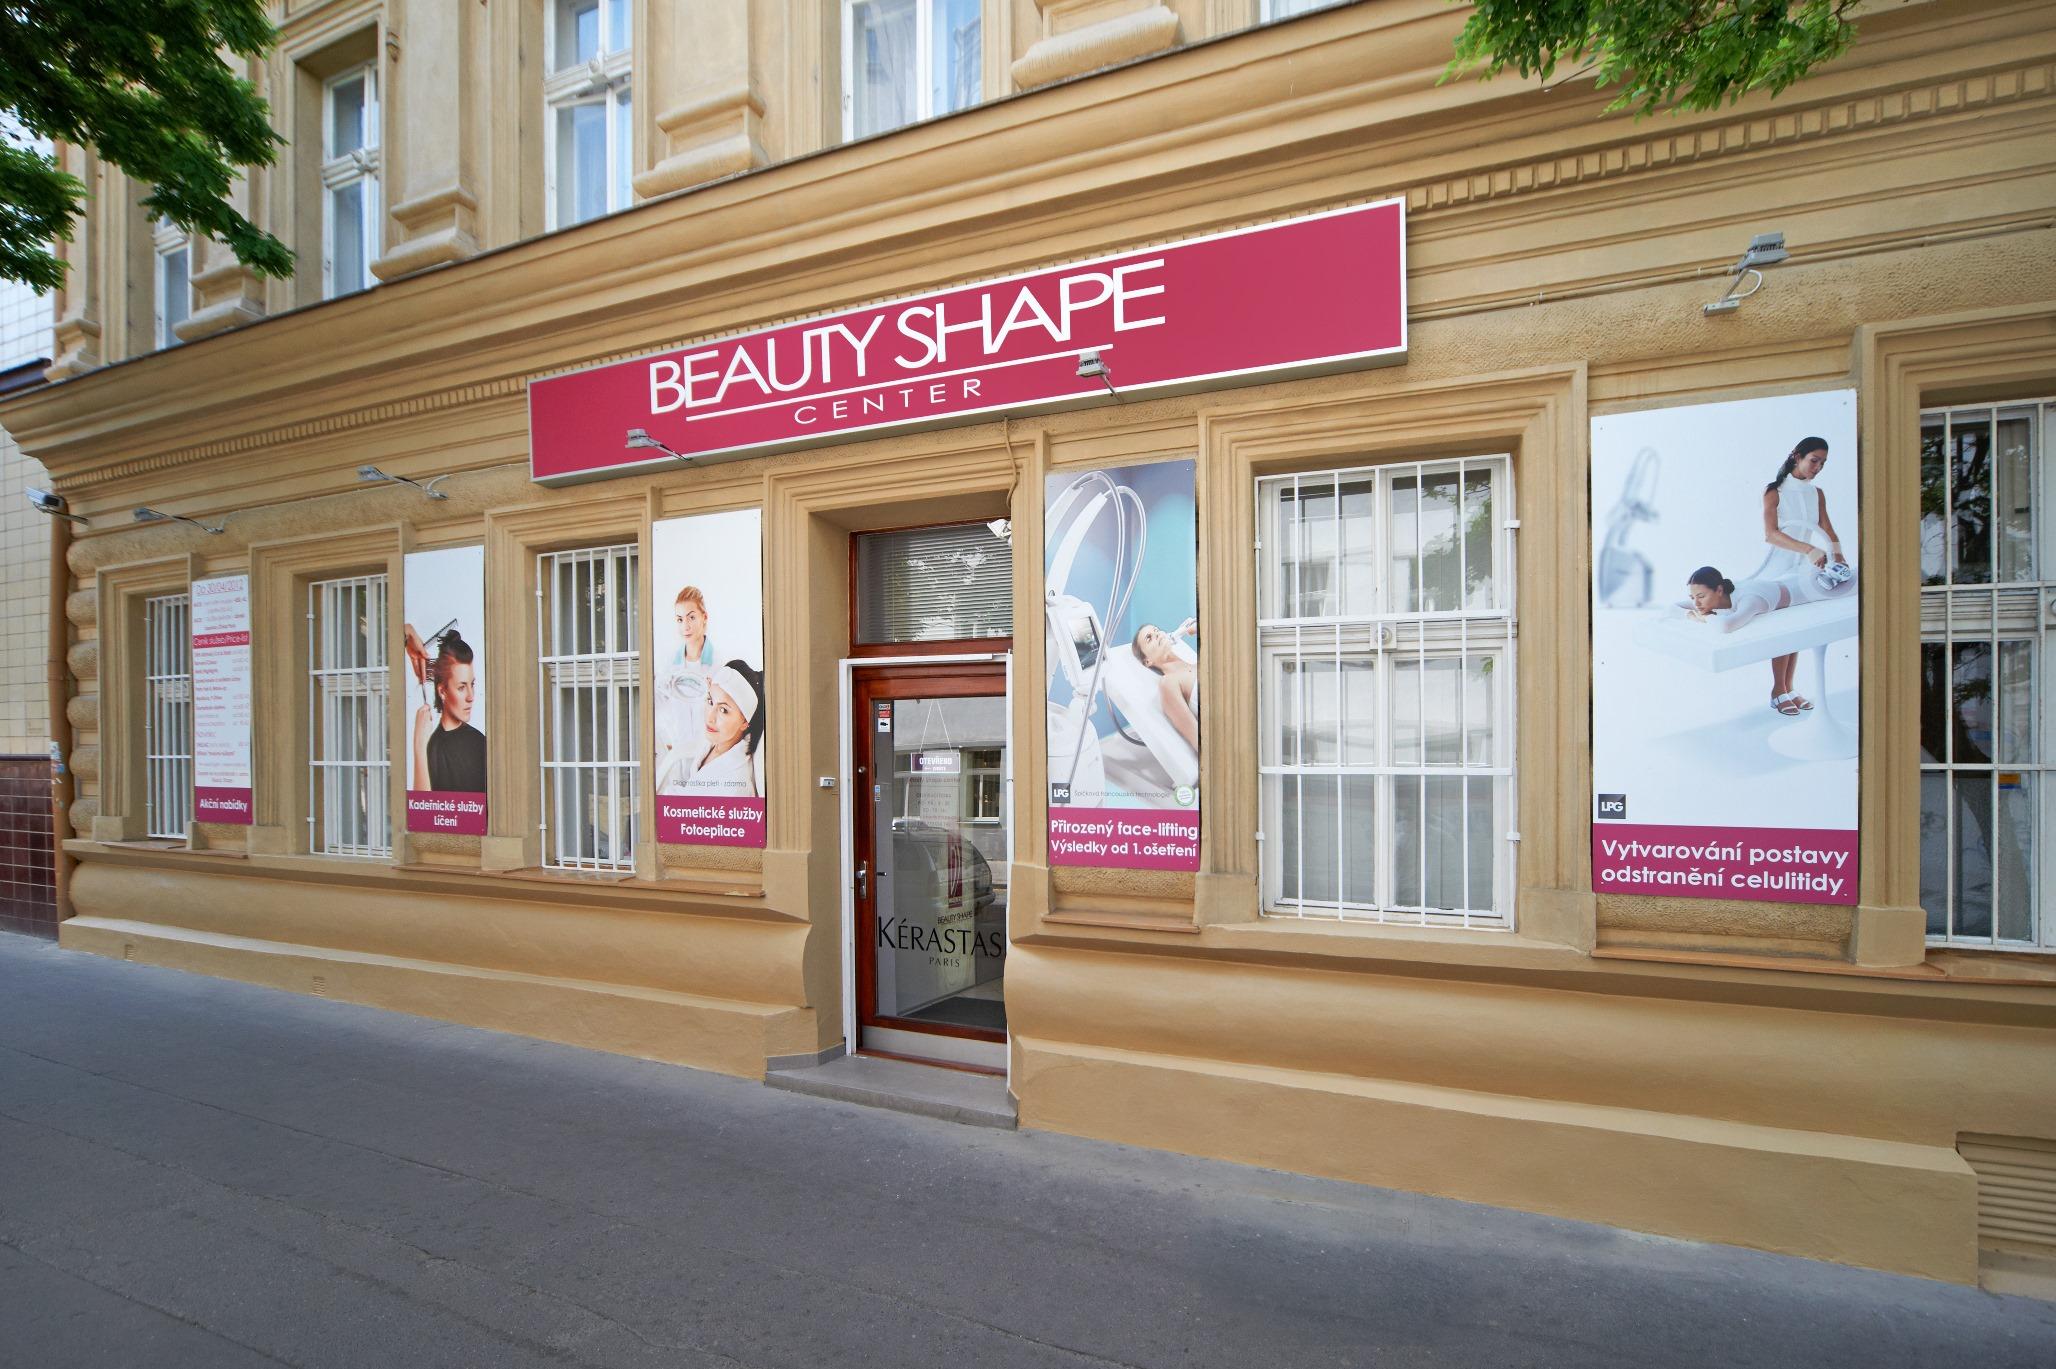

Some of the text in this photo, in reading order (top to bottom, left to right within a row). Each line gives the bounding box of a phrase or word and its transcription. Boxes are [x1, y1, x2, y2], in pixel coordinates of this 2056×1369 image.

[648, 258, 1165, 415] BEAUTY SHAPE
[794, 378, 982, 426] CENTER
[1054, 788, 1069, 798] LPG
[200, 798, 248, 812] Akční nabídky
[457, 801, 484, 815] služby
[663, 805, 763, 823] Kosmetické služby
[1602, 801, 1623, 812] LPG
[434, 815, 458, 826] Líčení
[1051, 819, 1198, 840] Přirozený face-lifting
[680, 823, 745, 838] Fotoepilace
[1051, 838, 1108, 856] Výsledky
[1111, 842, 1129, 855] od
[1601, 839, 1849, 868] Vytvarování postavy
[1601, 865, 1844, 895] odstranění celulitidy
[878, 916, 1006, 958] KÉRASTAS
[929, 956, 960, 967] PARIS
